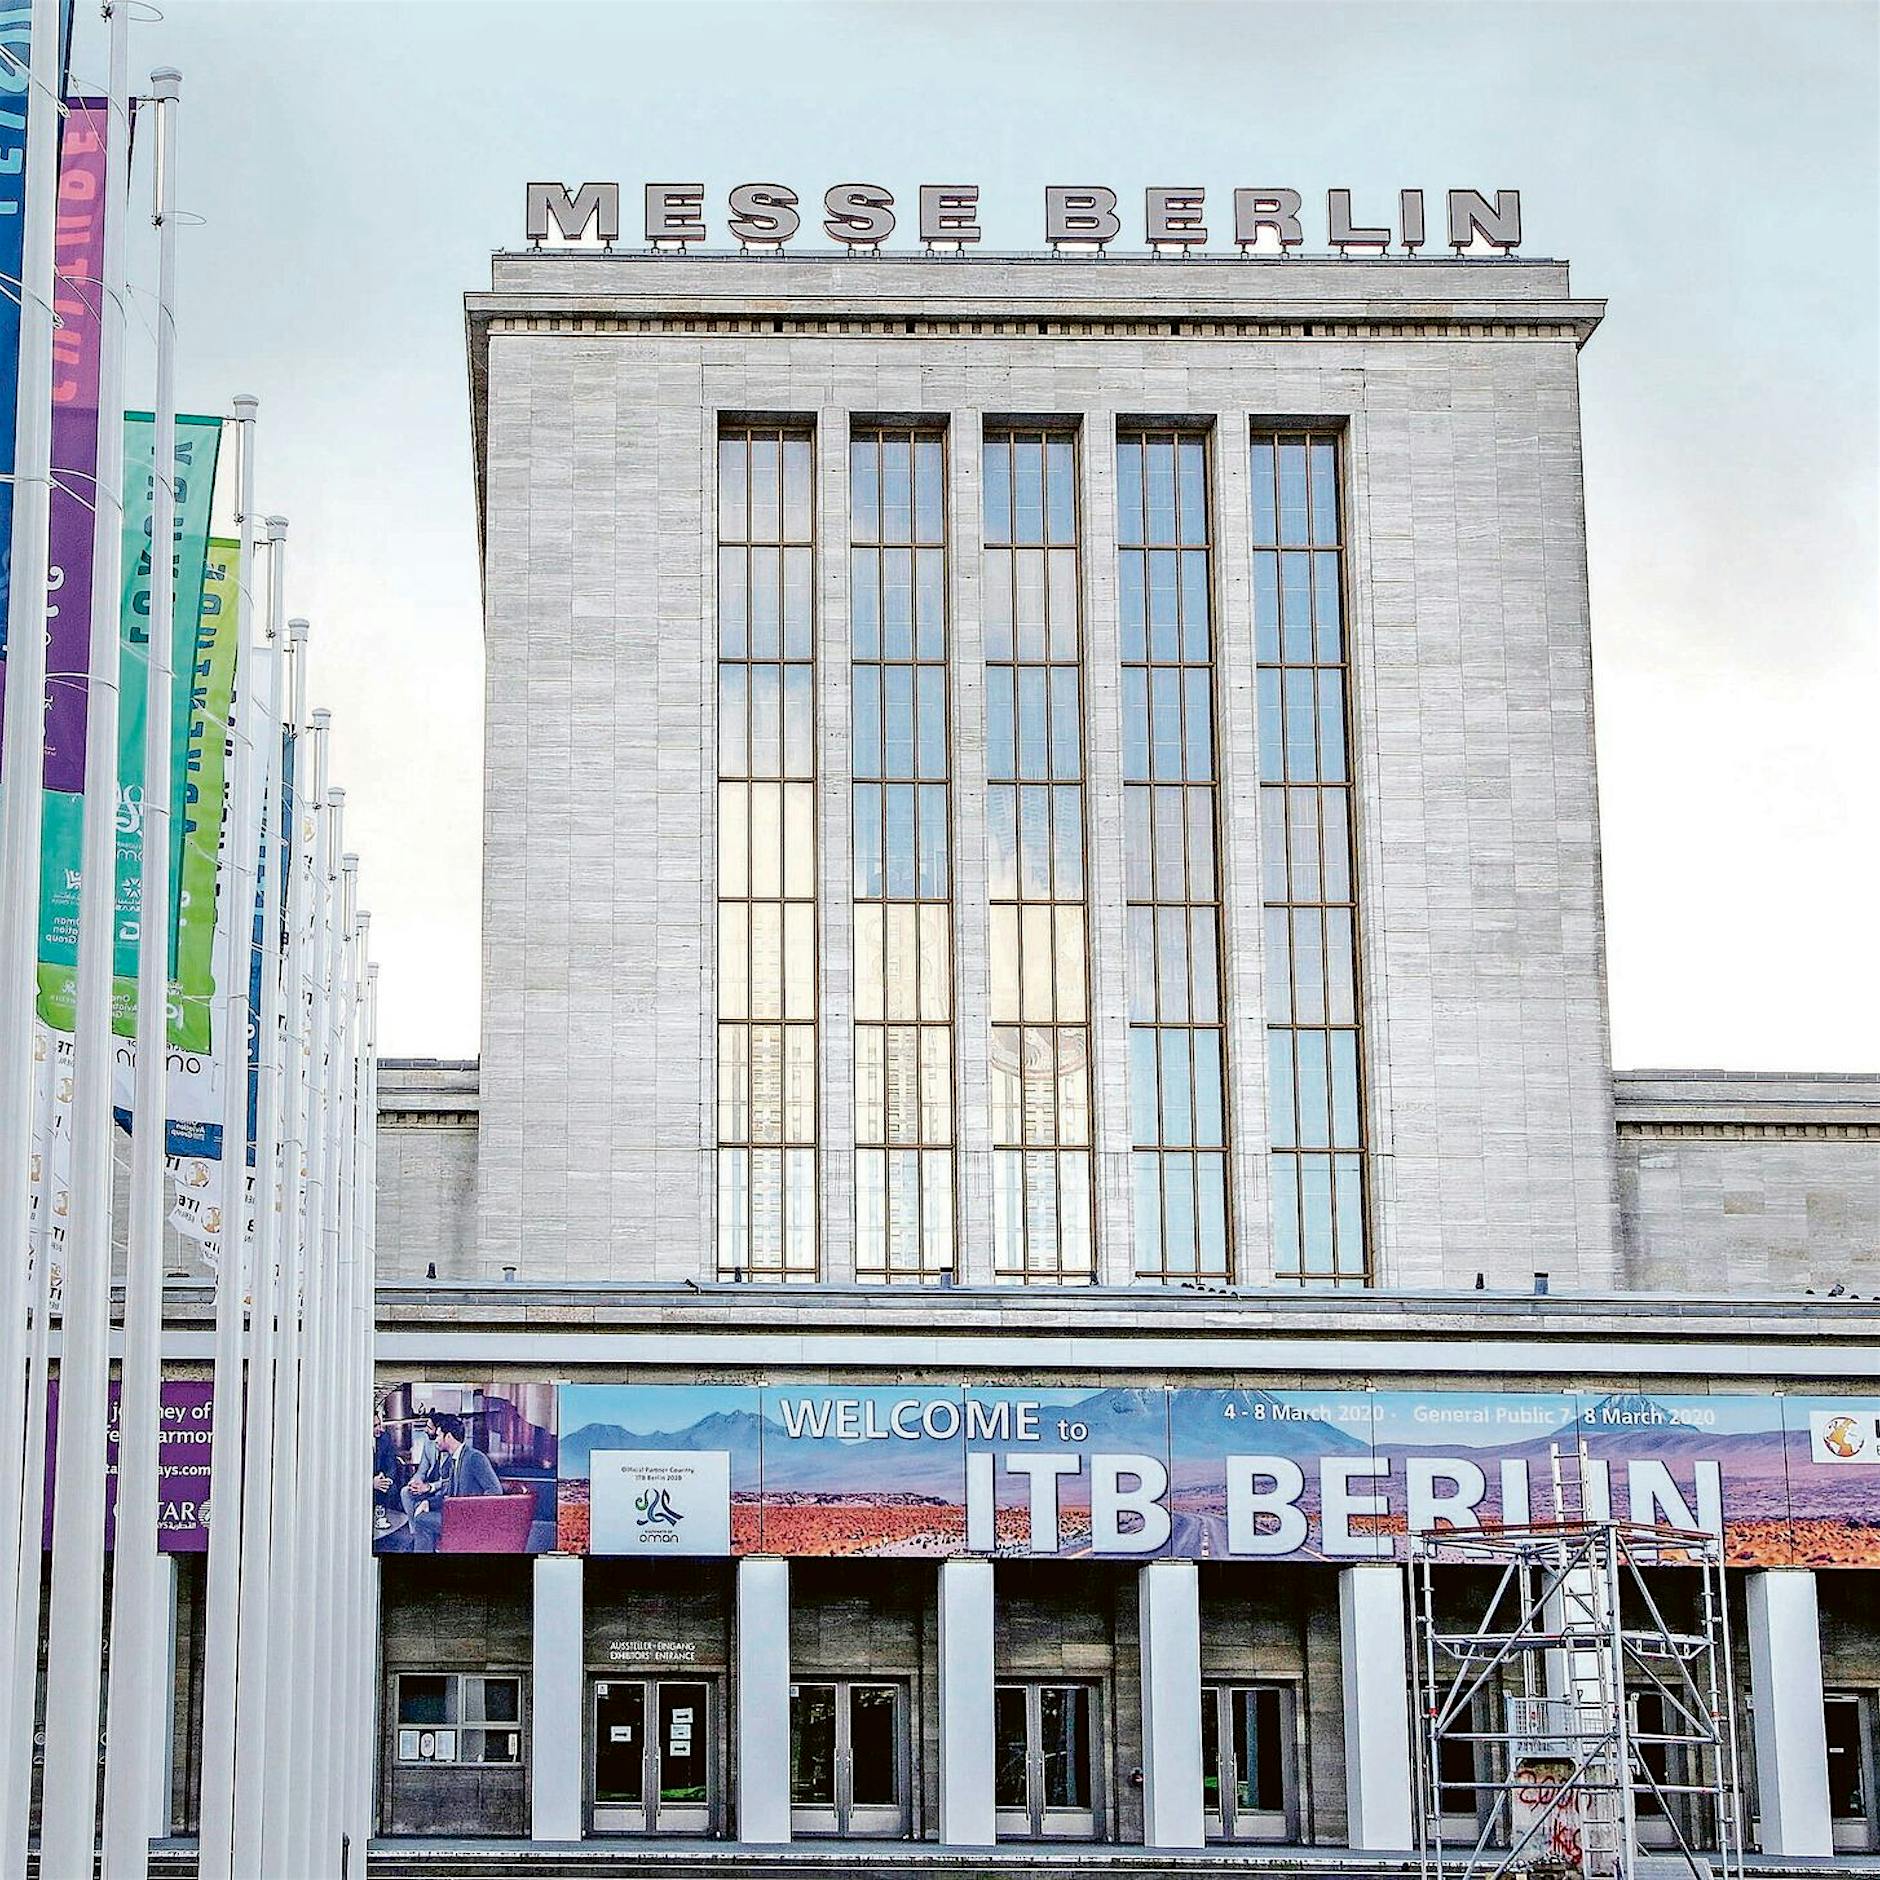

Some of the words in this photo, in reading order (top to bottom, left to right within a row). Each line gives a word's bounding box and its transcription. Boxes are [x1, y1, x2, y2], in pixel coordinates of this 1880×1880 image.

[526, 182, 981, 243] MESSE
[1045, 186, 1521, 247] BERLIN
[191, 1402, 212, 1419] of
[780, 1399, 1040, 1441] WELCOME
[1057, 1419, 1088, 1441] to
[1223, 1404, 1236, 1420] 4
[1254, 1404, 1266, 1420] 8
[1272, 1404, 1332, 1421] March
[1338, 1405, 1384, 1421] 2020
[1414, 1406, 1489, 1422] General
[1496, 1407, 1554, 1424] Public
[1584, 1408, 1596, 1424] 8
[1602, 1409, 1664, 1425] March
[1669, 1410, 1715, 1425] 2020
[965, 1452, 1170, 1553] ITB
[639, 1534, 679, 1543] oman
[655, 1651, 695, 1660] ENTRANCE
